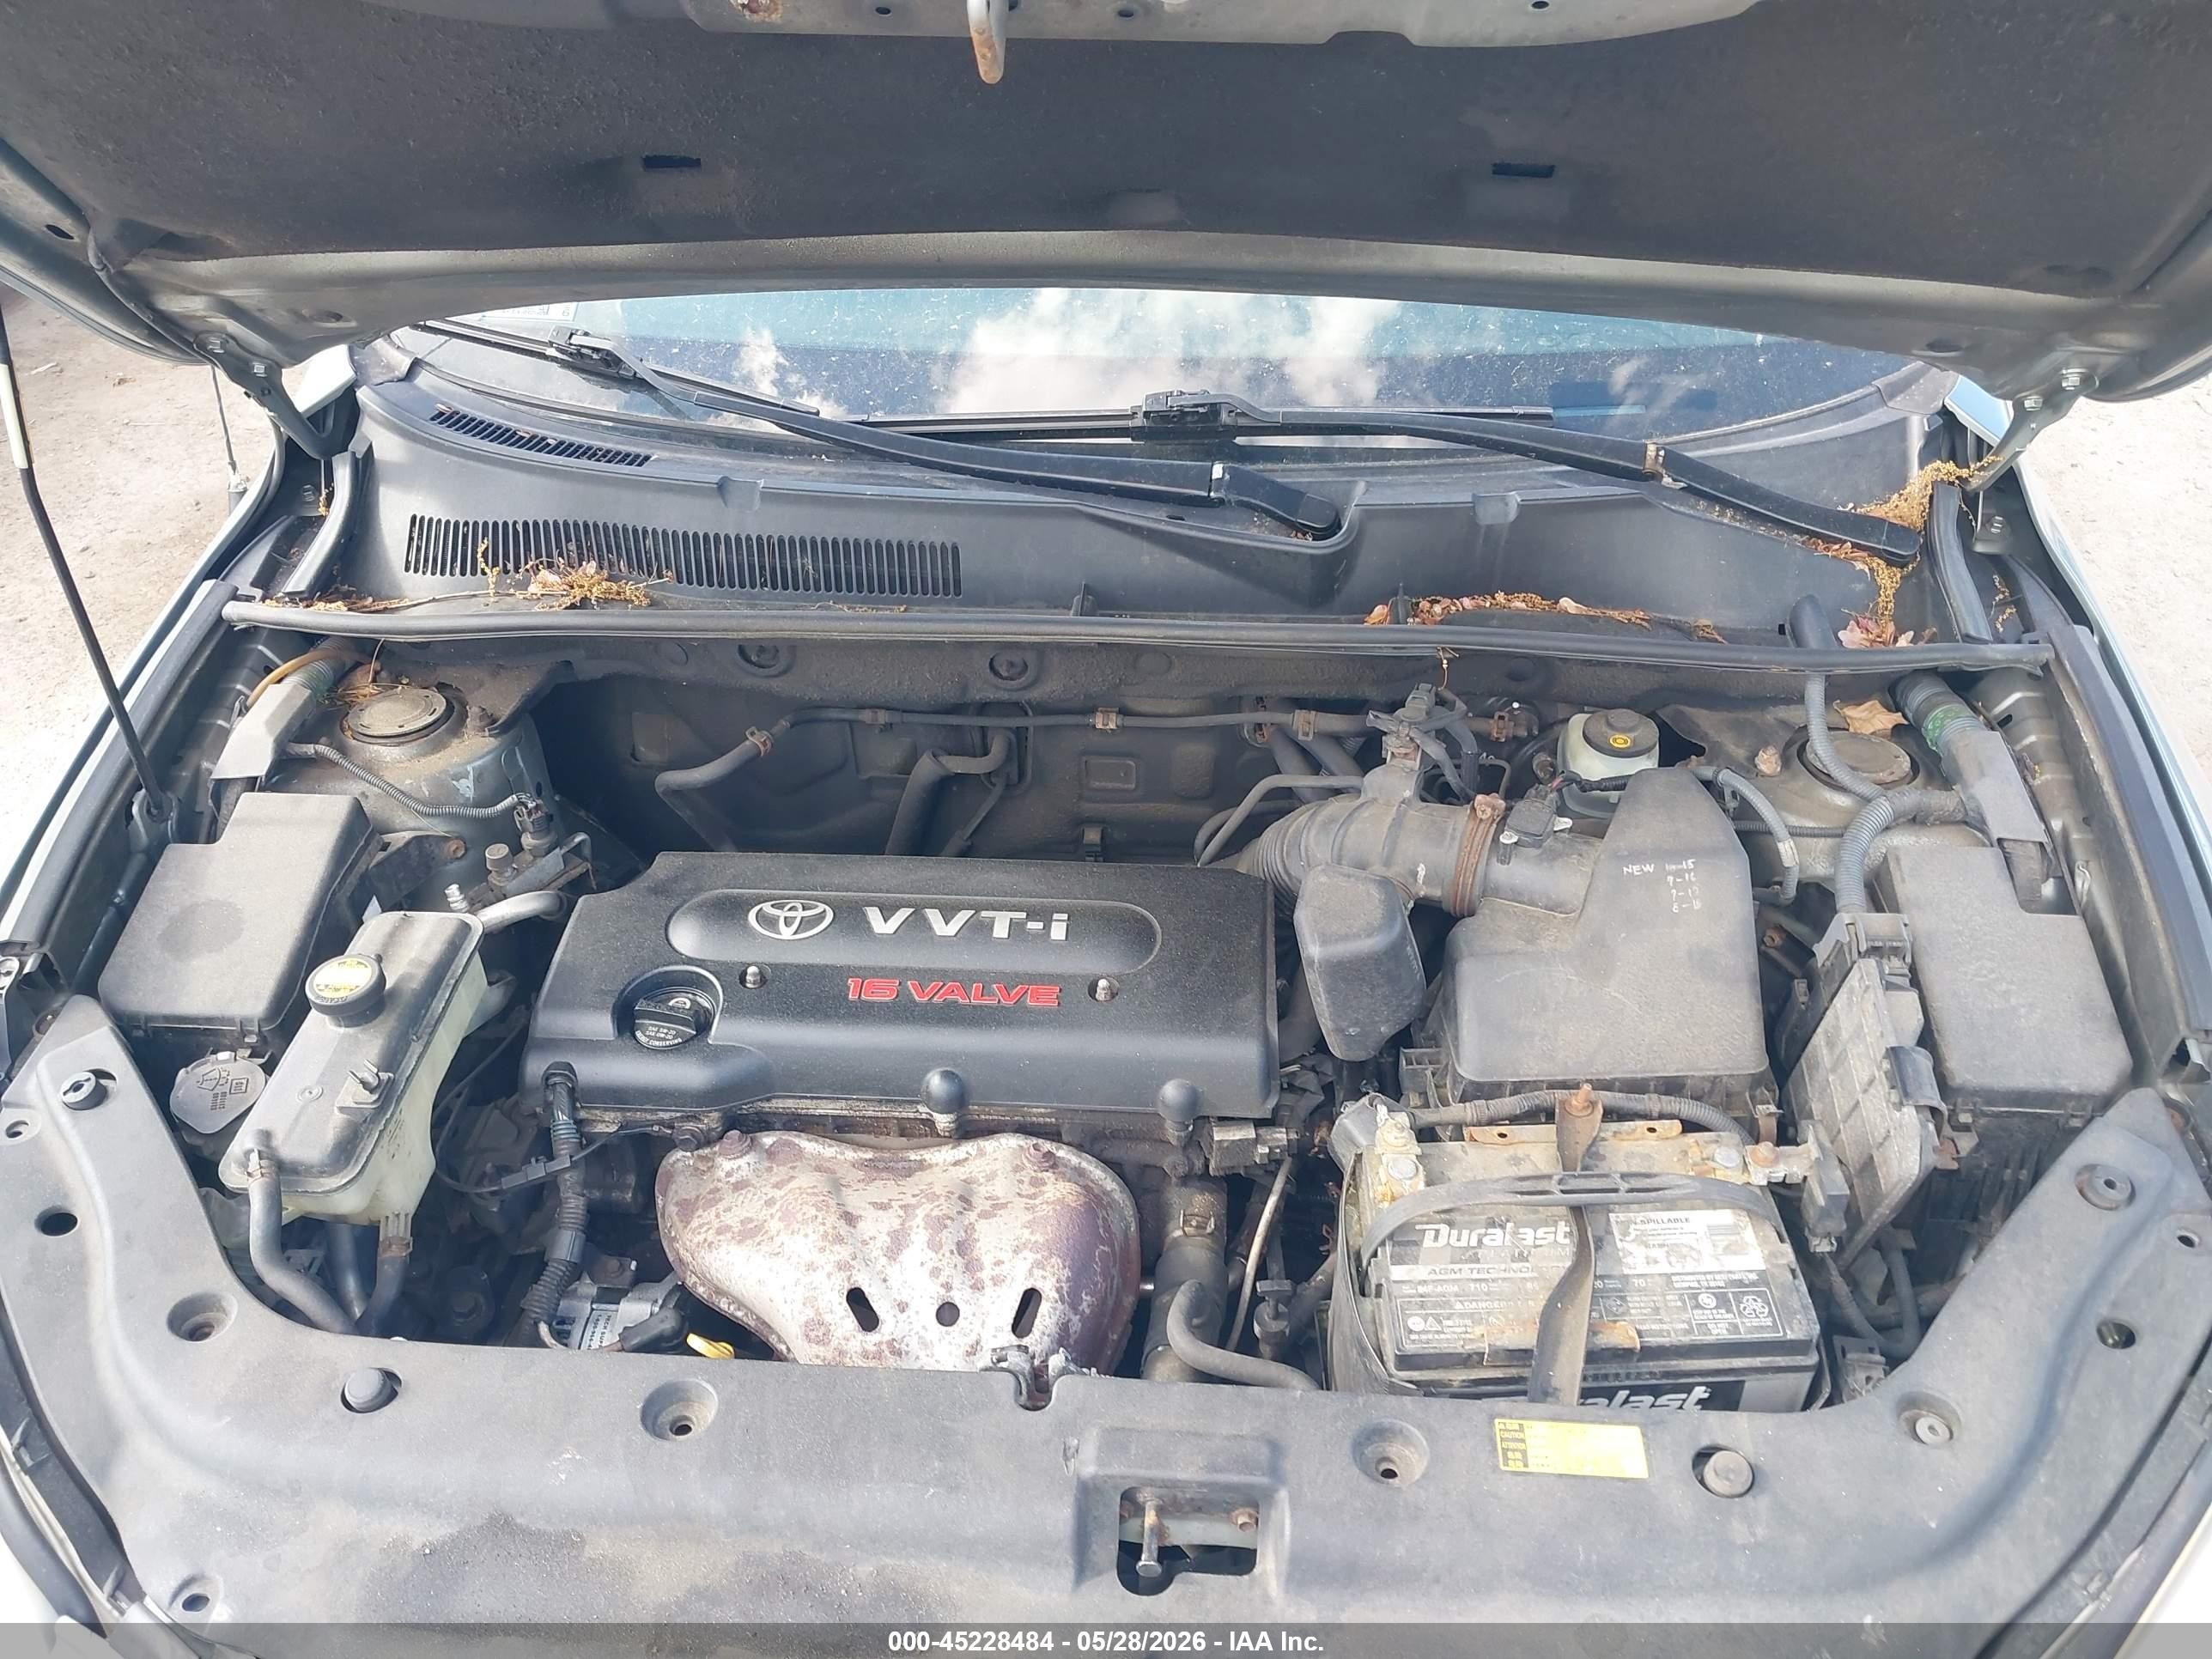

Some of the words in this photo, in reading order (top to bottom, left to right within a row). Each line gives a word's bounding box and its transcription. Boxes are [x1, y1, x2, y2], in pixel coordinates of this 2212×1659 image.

[1622, 864, 1655, 877] NEW
[864, 906, 1069, 941] VVT-i
[847, 978, 900, 1000] 16
[908, 981, 1061, 1006] VALVE
[1415, 1221, 1571, 1248] Duralast
[1428, 1267, 1463, 1276] AGM
[1468, 1283, 1488, 1292] 710
[1632, 1279, 1646, 1287] 70
